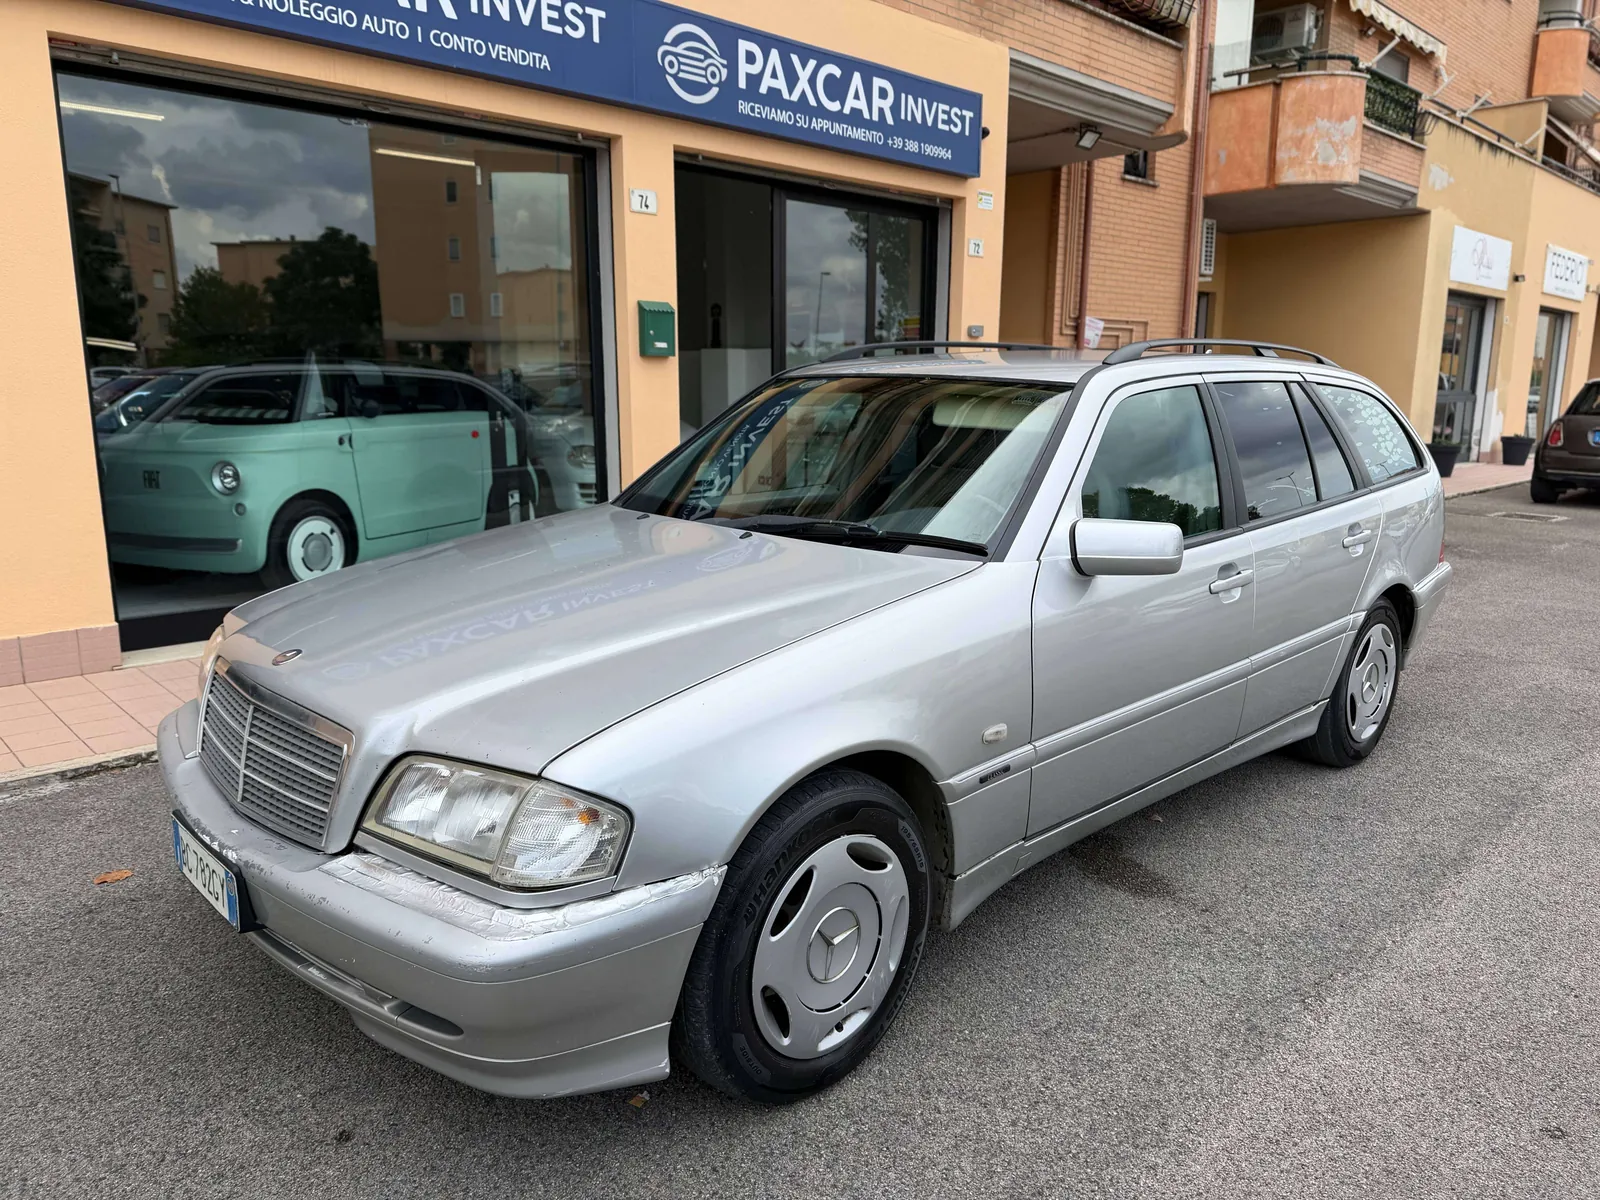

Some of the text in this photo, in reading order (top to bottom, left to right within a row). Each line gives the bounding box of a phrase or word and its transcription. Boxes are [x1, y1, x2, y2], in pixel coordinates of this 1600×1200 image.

[259, 0, 358, 28] NOLEGGIO
[362, 14, 410, 39] AUTO
[430, 29, 486, 57] CONTO
[488, 42, 551, 71] VENDITA
[737, 39, 974, 136] PAXCAR INVEST
[738, 100, 952, 160] RICEVIAMO SU APPUNTAMENTO +39 388 1909964
[638, 194, 650, 210] 74
[973, 242, 981, 255] 72
